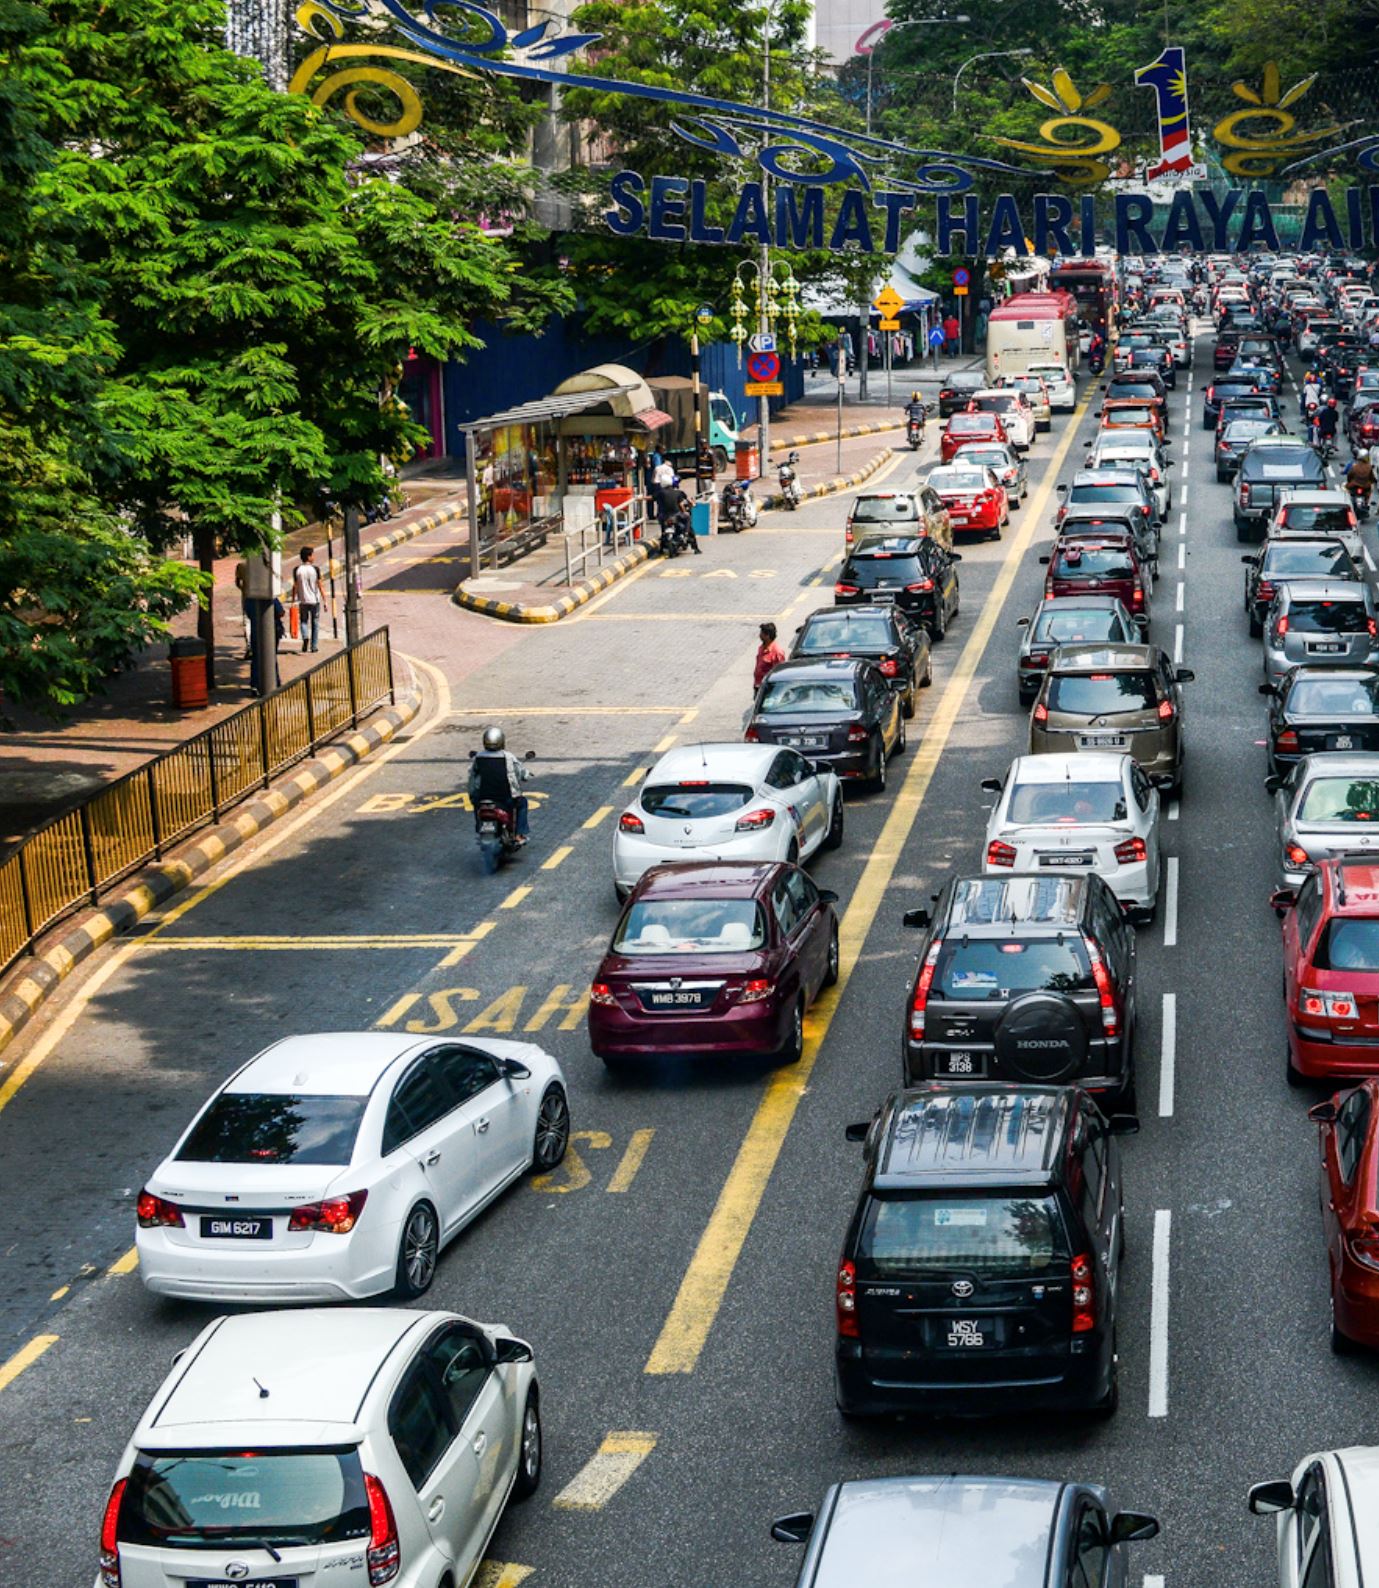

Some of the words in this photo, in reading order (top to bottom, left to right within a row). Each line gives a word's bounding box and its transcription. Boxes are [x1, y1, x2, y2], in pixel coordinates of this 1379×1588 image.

[606, 170, 915, 253] SELAMAT
[937, 193, 1097, 258] HARI
[1115, 189, 1280, 255] RAYA
[660, 568, 778, 578] BAS
[652, 993, 674, 1004] WMB
[1016, 1039, 1070, 1049] HONDA
[948, 1062, 972, 1073] 3138
[233, 1222, 261, 1235] 6217
[951, 1320, 978, 1333] WSY
